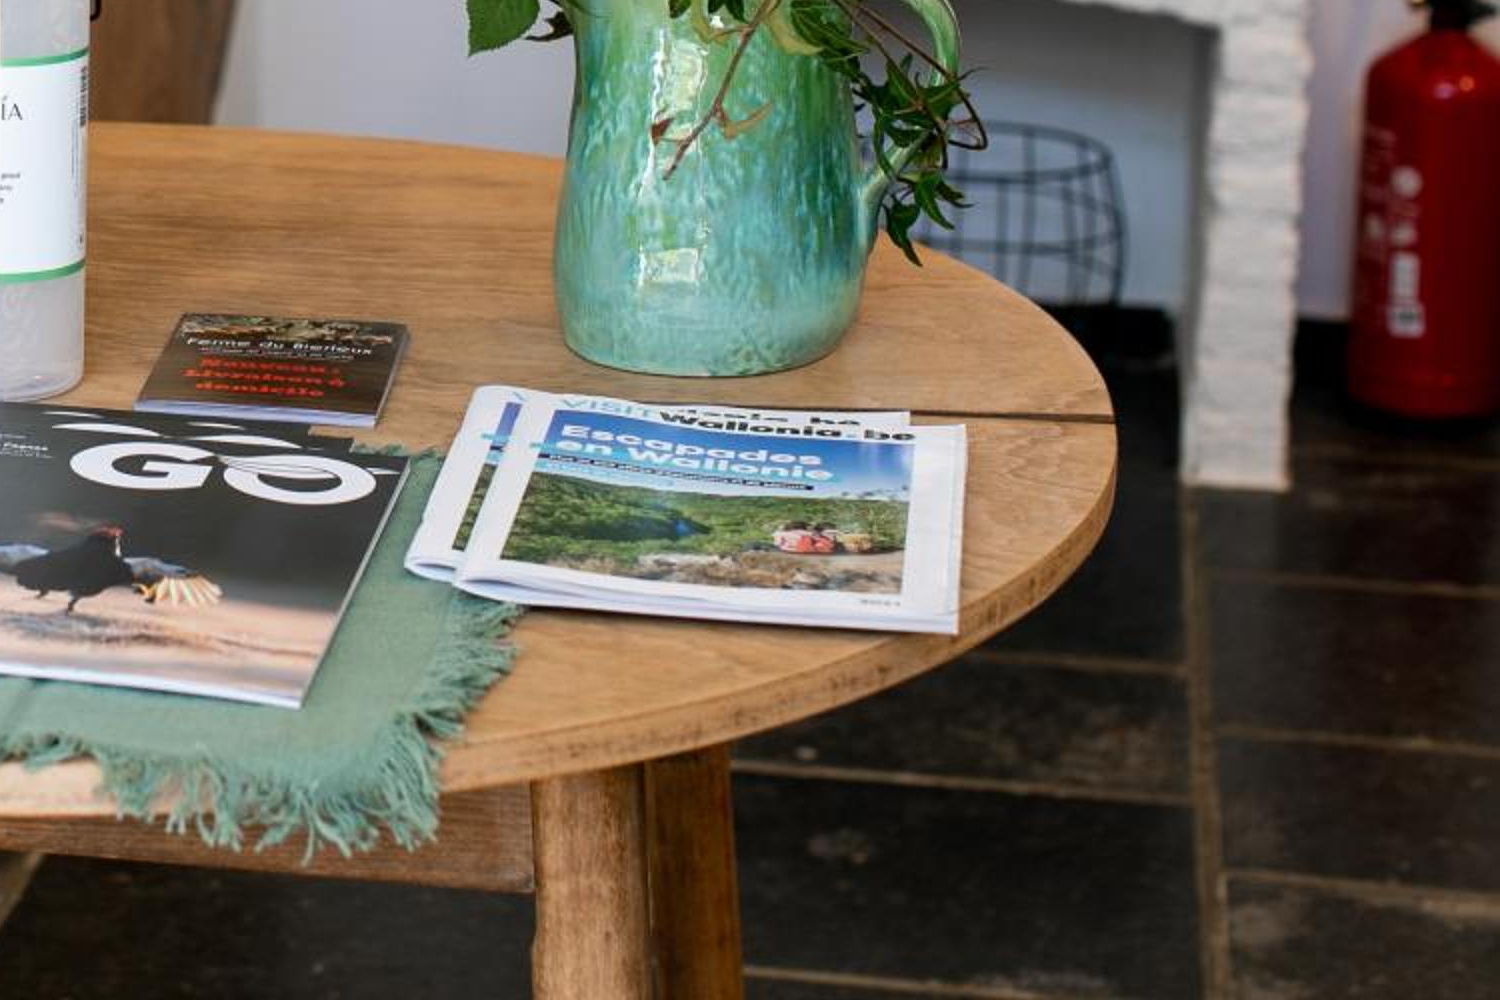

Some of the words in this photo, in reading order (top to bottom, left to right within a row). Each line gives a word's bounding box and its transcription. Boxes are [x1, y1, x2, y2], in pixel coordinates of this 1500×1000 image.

[187, 336, 251, 347] Ferme
[258, 339, 284, 350] du
[555, 440, 614, 457] en
[627, 447, 834, 482] Wallonie
[561, 424, 822, 466] Escapades
[69, 440, 377, 506] GO
